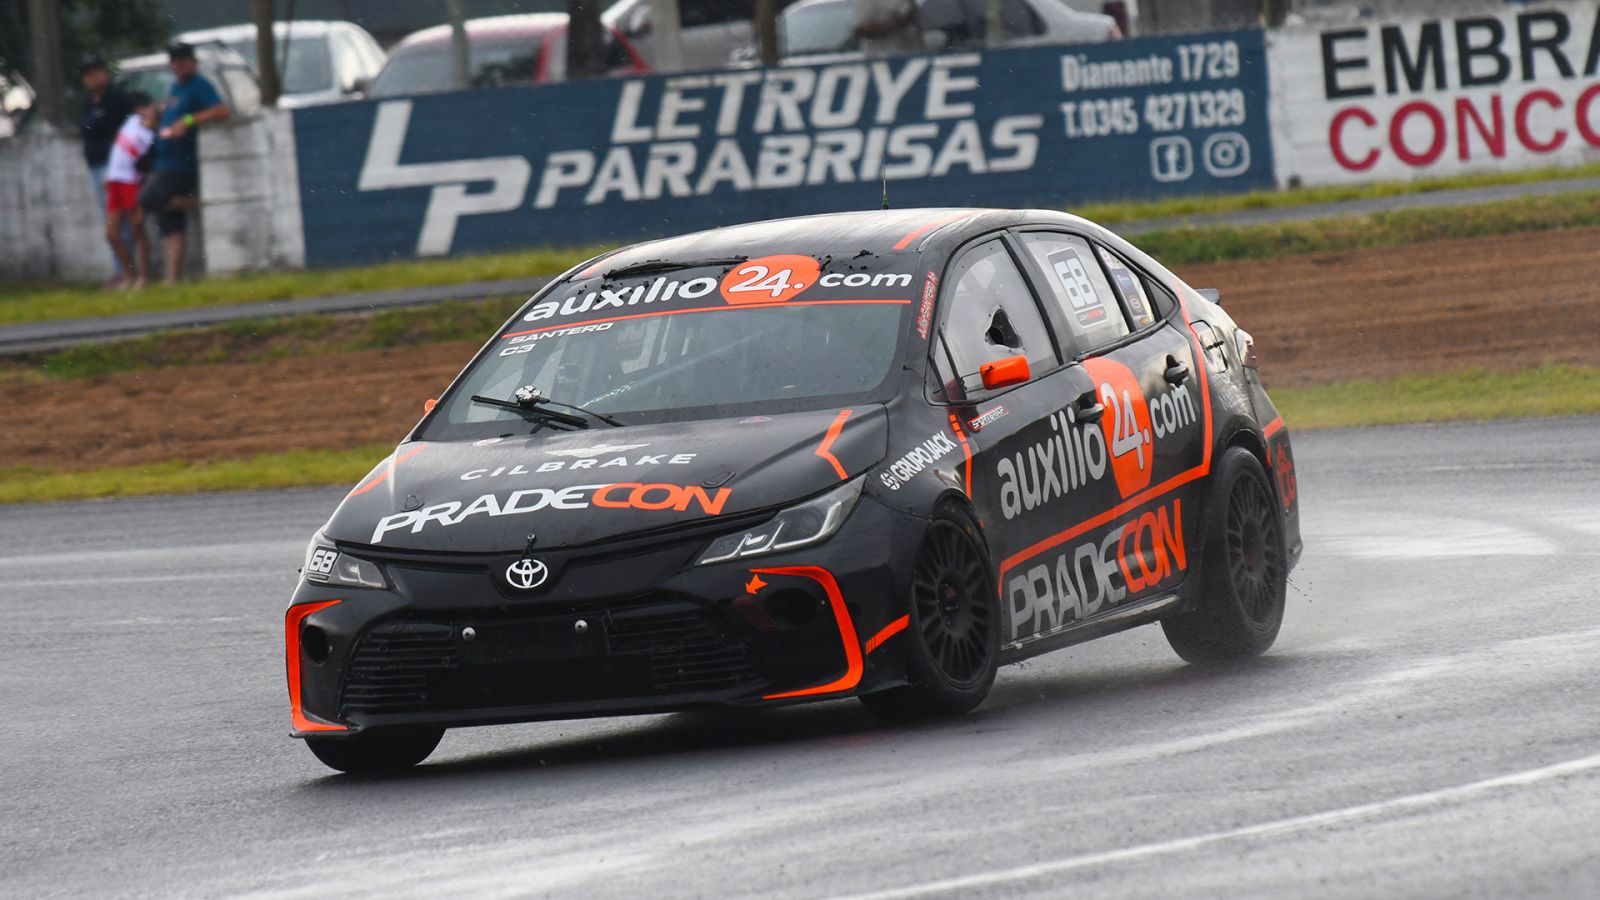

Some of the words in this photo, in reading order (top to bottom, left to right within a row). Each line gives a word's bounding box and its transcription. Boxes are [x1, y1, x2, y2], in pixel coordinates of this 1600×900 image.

[1061, 53, 1173, 92] Diamante
[1177, 40, 1240, 81] 1729
[1321, 6, 1600, 100] EMBR
[611, 53, 982, 143] LETROYE
[1060, 97, 1139, 139] T.0345
[534, 114, 1044, 210] PARABRISAS
[1054, 257, 1098, 309] 68
[499, 343, 536, 357] C3
[508, 322, 614, 345] SANTERO
[460, 452, 698, 481] CILBRAKE
[370, 482, 733, 544] PRADECON
[309, 549, 338, 574] 68
[1007, 497, 1187, 639] PRADECON
